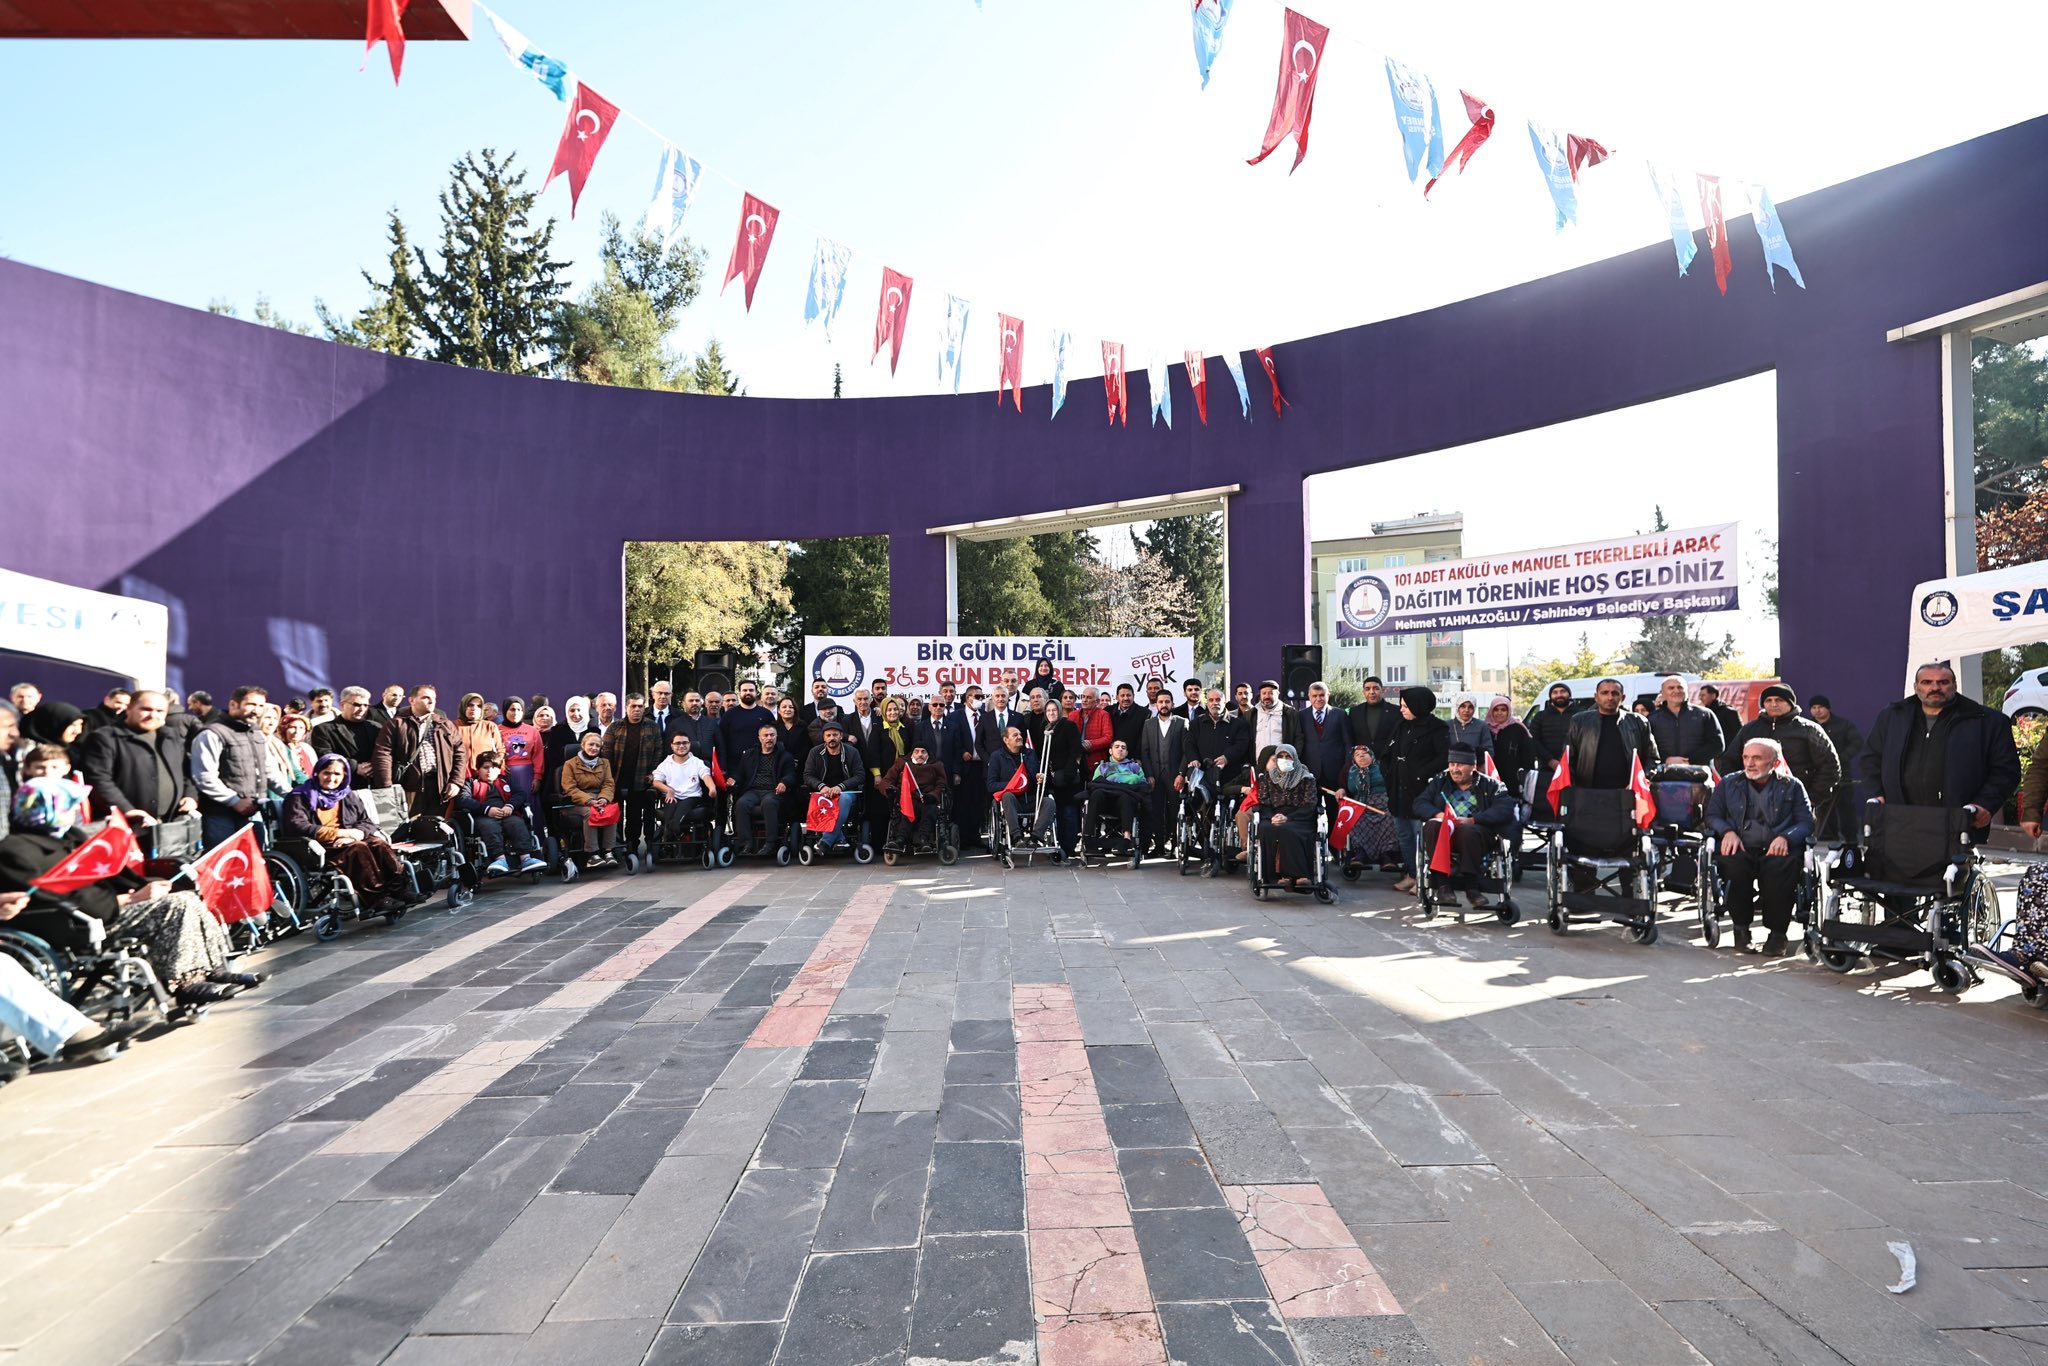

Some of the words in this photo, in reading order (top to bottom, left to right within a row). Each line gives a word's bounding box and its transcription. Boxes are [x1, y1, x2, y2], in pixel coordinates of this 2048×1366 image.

[1394, 573, 1412, 587] 101
[1414, 568, 1446, 585] ADET
[1448, 561, 1490, 580] AKÜLÜ
[1494, 564, 1508, 575] ve
[1512, 554, 1570, 573] MANUEL
[1575, 538, 1668, 566] TEKERLEKLİ
[1672, 534, 1721, 555] ARAÇ
[1394, 588, 1462, 611] DAĞITIM
[1466, 578, 1560, 604] TÖRENİNE
[1566, 573, 1609, 595] HOŞ
[1615, 558, 1724, 590] GELDİNİZ
[1395, 618, 1437, 630] Mehmet
[1439, 610, 1520, 627] TAHMAZOĞLU
[1522, 608, 1530, 622] /
[1533, 604, 1593, 621] Şahinbey
[1596, 599, 1660, 614] Belediye
[1663, 595, 1726, 610] Başkanı
[917, 639, 953, 661] BİR
[959, 639, 1006, 661] GÜN
[1012, 639, 1076, 661] DEĞİL
[1131, 646, 1175, 669] engel
[935, 663, 982, 685] GÜN
